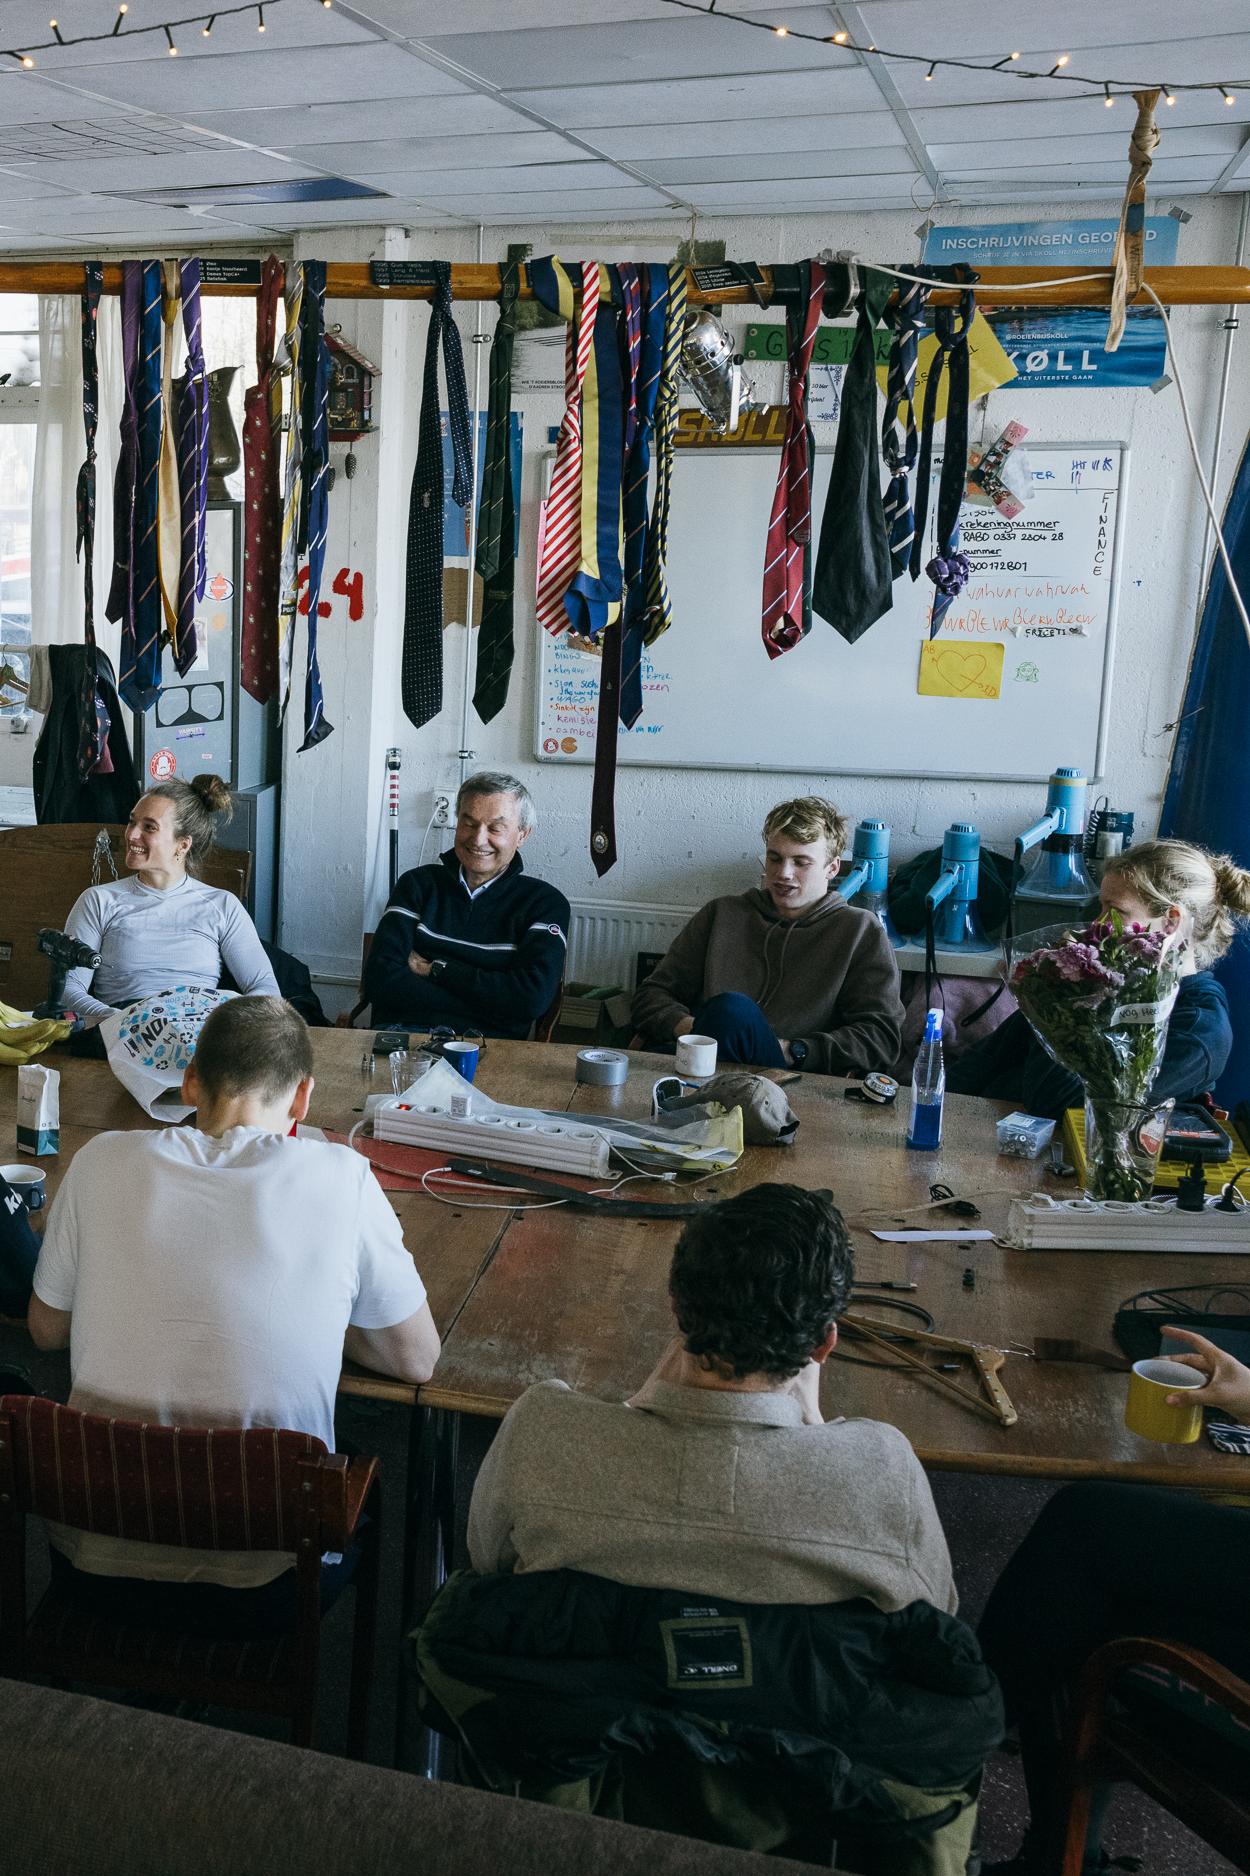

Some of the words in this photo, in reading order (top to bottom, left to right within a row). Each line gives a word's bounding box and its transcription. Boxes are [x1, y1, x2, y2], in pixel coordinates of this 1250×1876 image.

[941, 233, 1073, 250] INSCHRIJVINGEN
[1007, 349, 1098, 374] KØLL
[993, 533, 1017, 541] 0337
[1051, 532, 1064, 541] 28
[555, 652, 581, 660] BINGO
[178, 727, 203, 735] VARSITY
